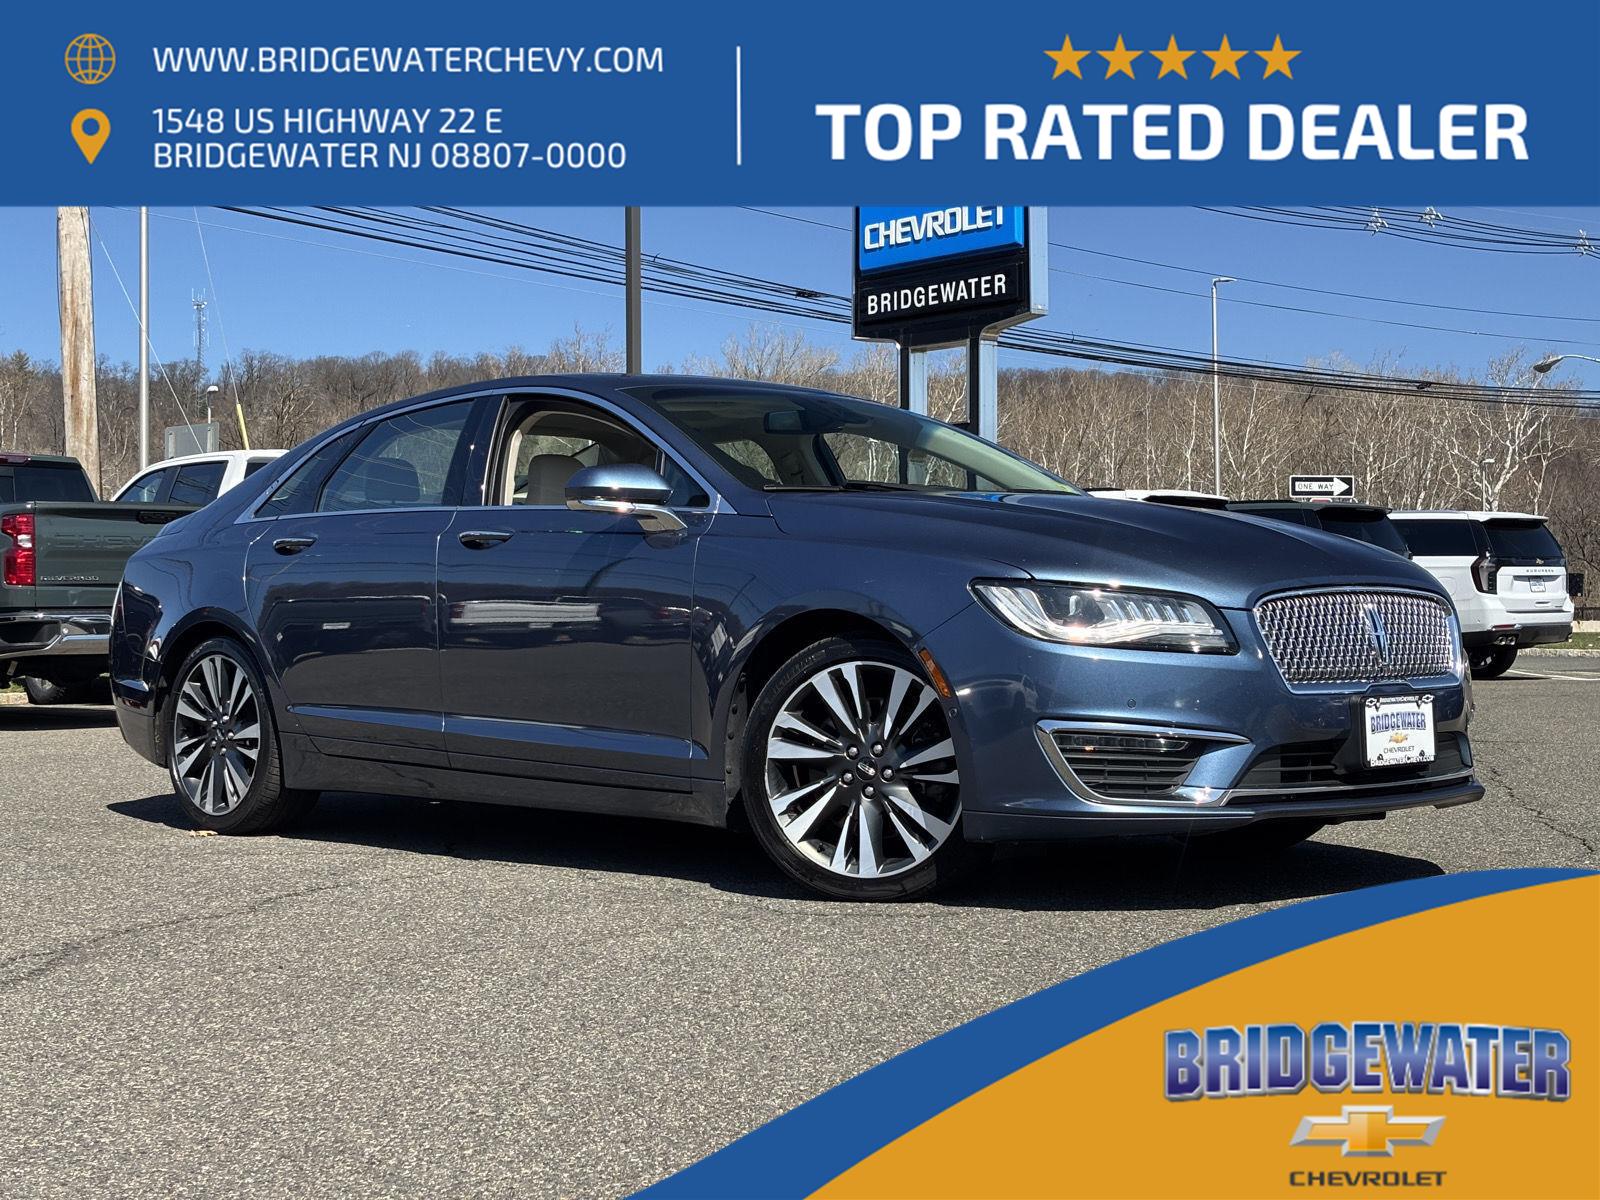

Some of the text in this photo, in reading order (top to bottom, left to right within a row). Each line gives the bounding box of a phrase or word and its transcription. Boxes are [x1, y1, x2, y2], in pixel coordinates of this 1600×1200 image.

[867, 273, 1006, 316] BRIDGEWATER
[1297, 482, 1334, 490] ONE WAY
[1370, 710, 1427, 734] BRIDGEWATER
[1383, 745, 1415, 754] CHEVROLET
